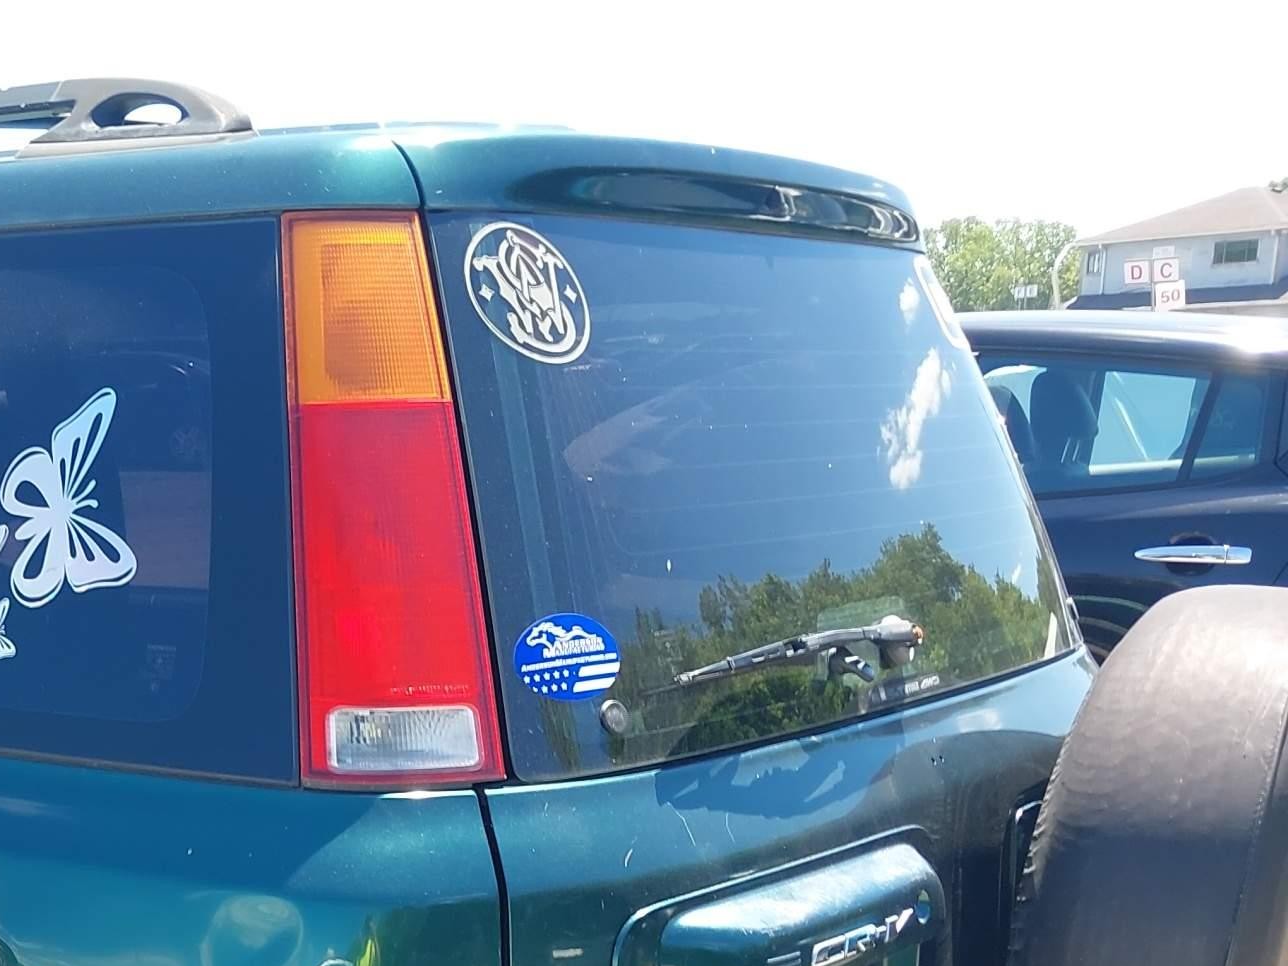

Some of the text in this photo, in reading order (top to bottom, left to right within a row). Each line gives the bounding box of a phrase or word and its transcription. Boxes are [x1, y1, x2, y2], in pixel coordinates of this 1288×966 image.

[1130, 262, 1172, 280] D C
[1160, 288, 1181, 304] 50
